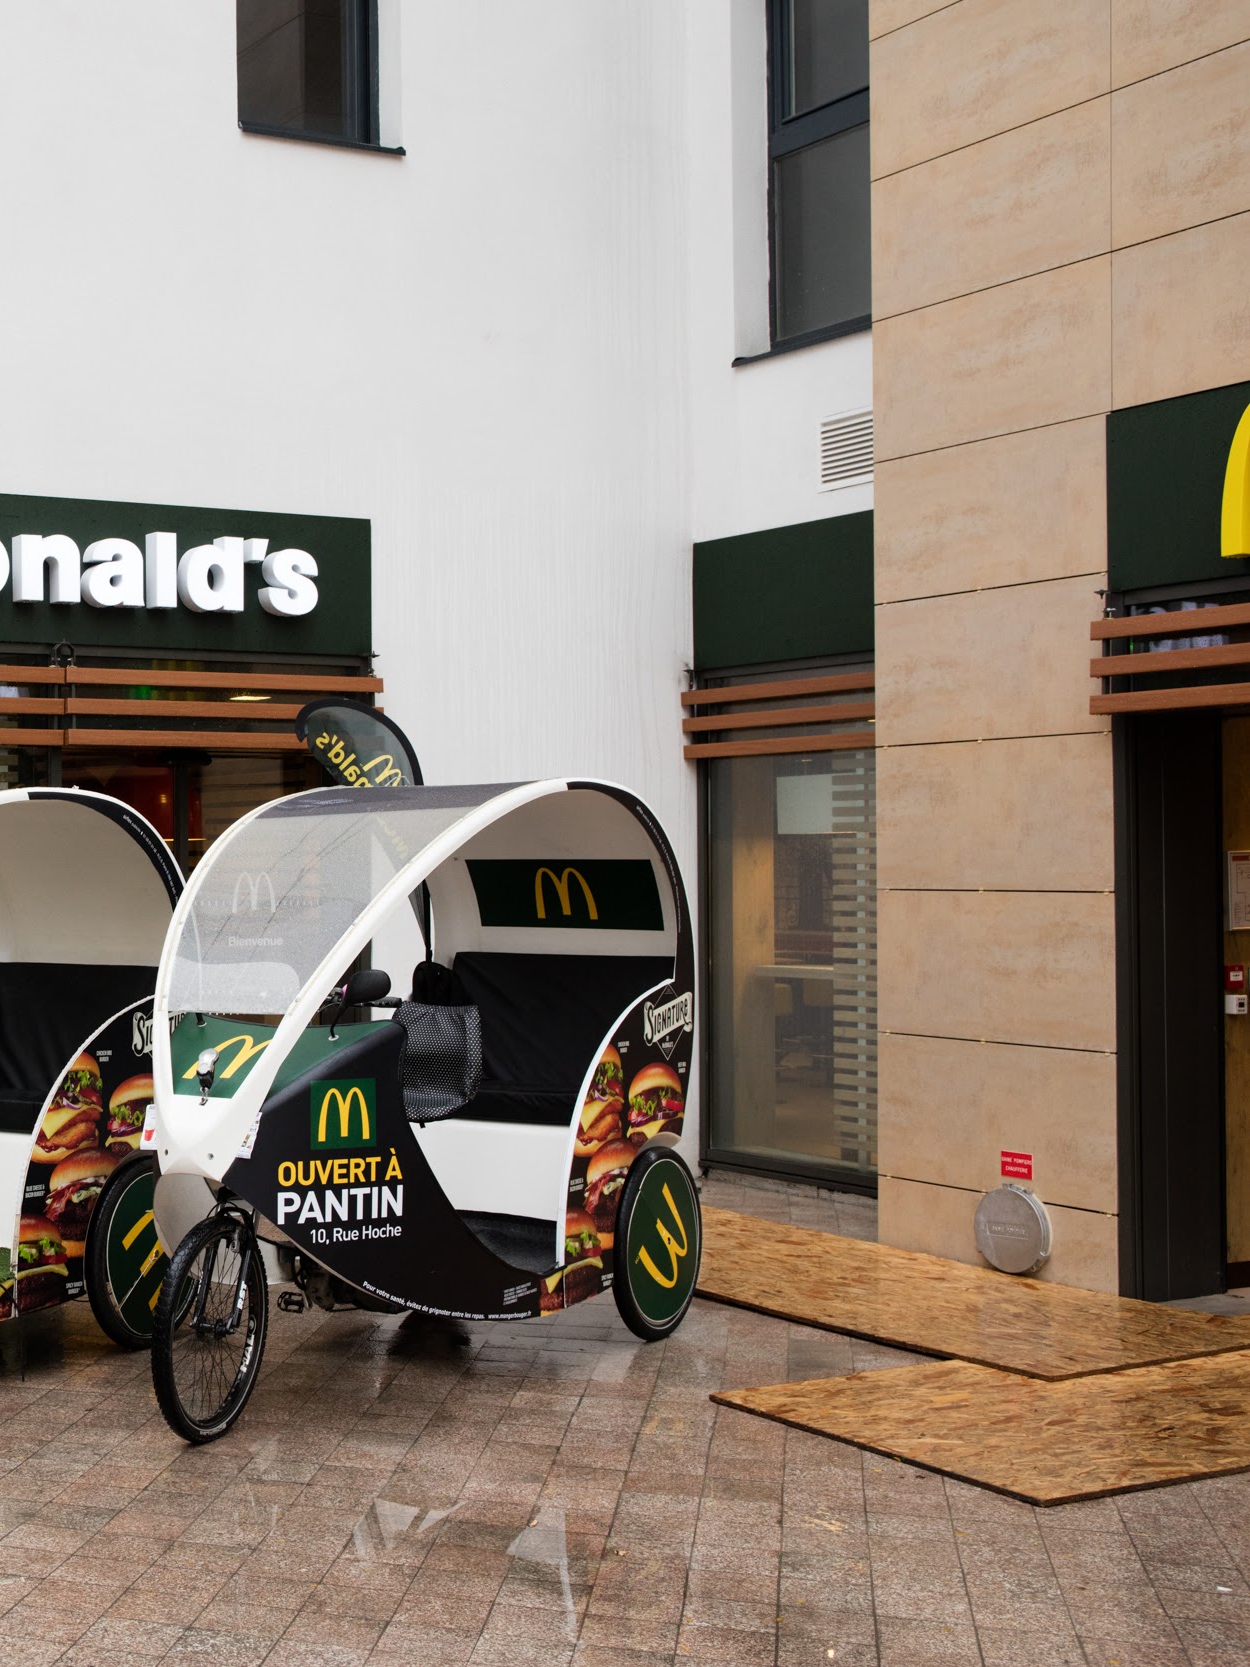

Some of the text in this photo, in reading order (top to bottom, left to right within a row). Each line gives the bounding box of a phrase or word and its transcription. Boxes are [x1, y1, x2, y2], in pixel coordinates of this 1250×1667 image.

[228, 936, 283, 947] Bienvenue
[277, 1148, 403, 1187] OUVERT À
[1005, 1165, 1028, 1174] CHAUFFERIE
[276, 1184, 404, 1225] PANTIN
[310, 1223, 402, 1245] 10, Rue Hoche
[362, 1281, 376, 1292] Pour
[376, 1288, 390, 1299] votre
[390, 1295, 405, 1306] santé,
[406, 1300, 422, 1310] évitez
[428, 1307, 452, 1316] grignoter
